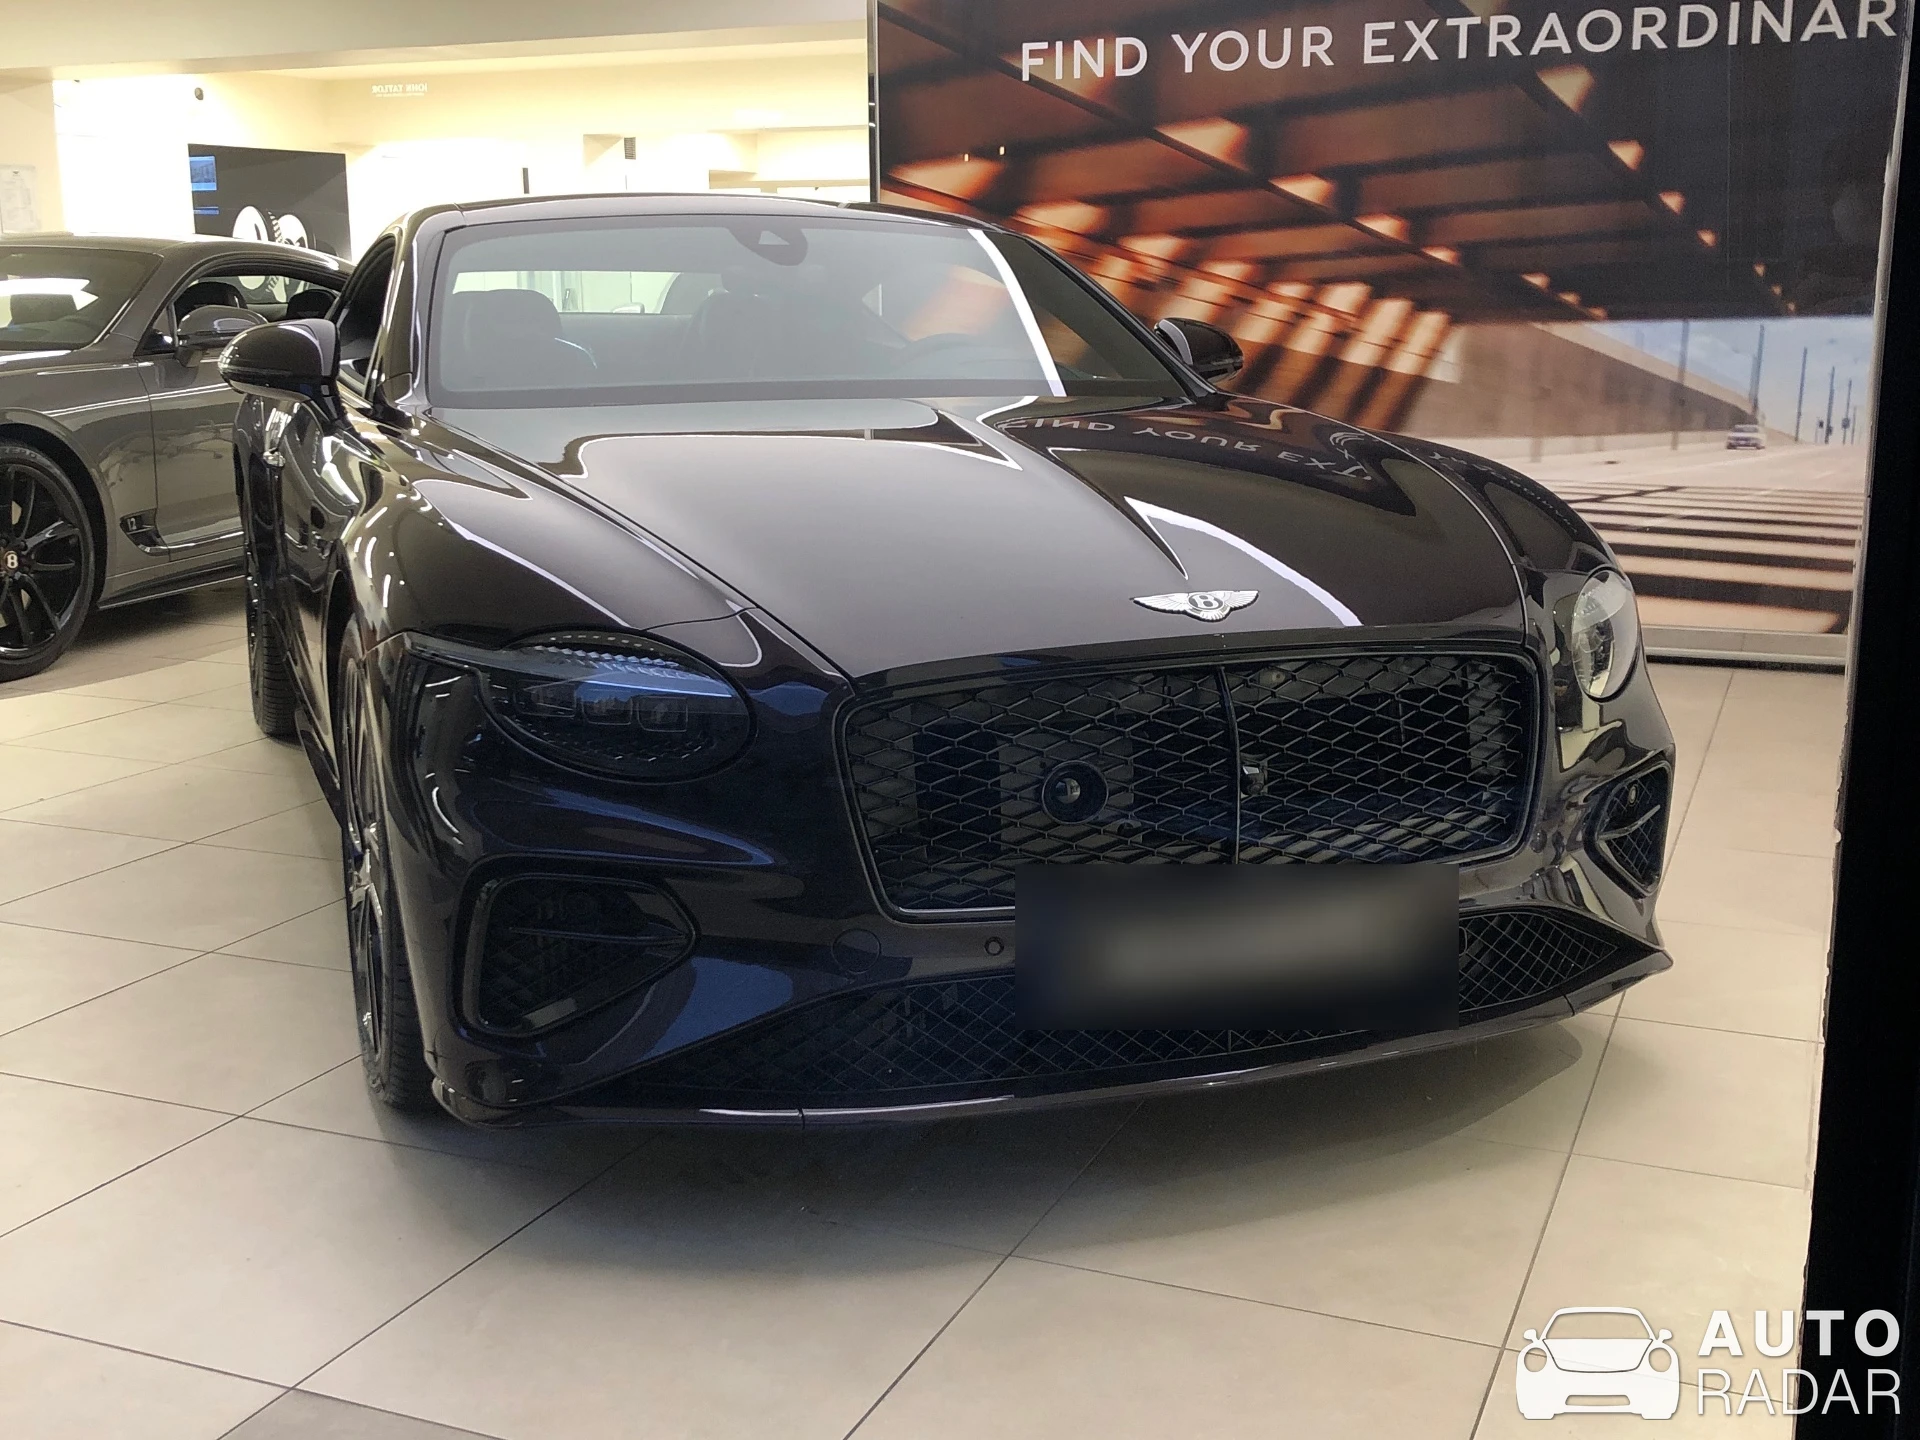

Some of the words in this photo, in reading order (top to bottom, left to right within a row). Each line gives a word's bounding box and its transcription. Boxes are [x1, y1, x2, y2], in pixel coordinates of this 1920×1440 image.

[1022, 37, 1148, 81] FIND
[1171, 25, 1335, 73] YOUR
[1363, 0, 1897, 64] EXTRAORDINAR
